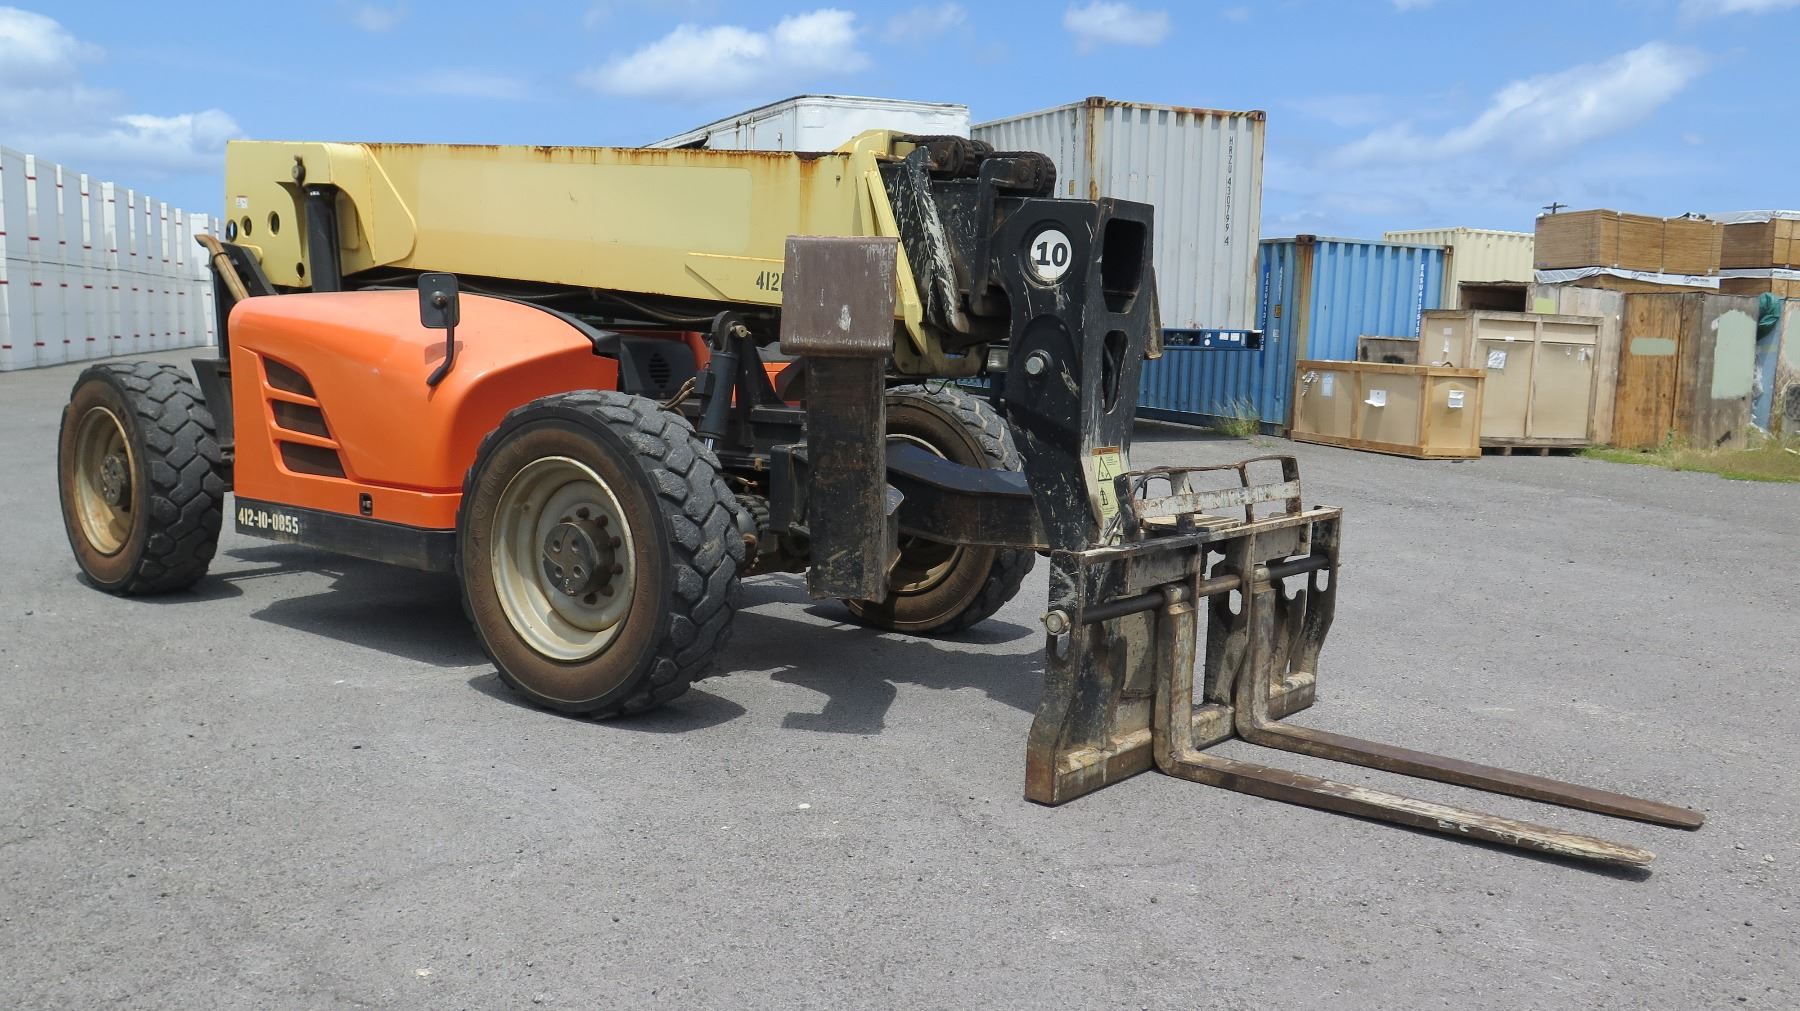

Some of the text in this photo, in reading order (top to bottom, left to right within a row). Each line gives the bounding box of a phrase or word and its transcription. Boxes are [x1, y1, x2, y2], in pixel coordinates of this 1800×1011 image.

[1036, 241, 1068, 267] 10
[755, 270, 784, 292] 412
[238, 507, 299, 535] 412-10-0855
